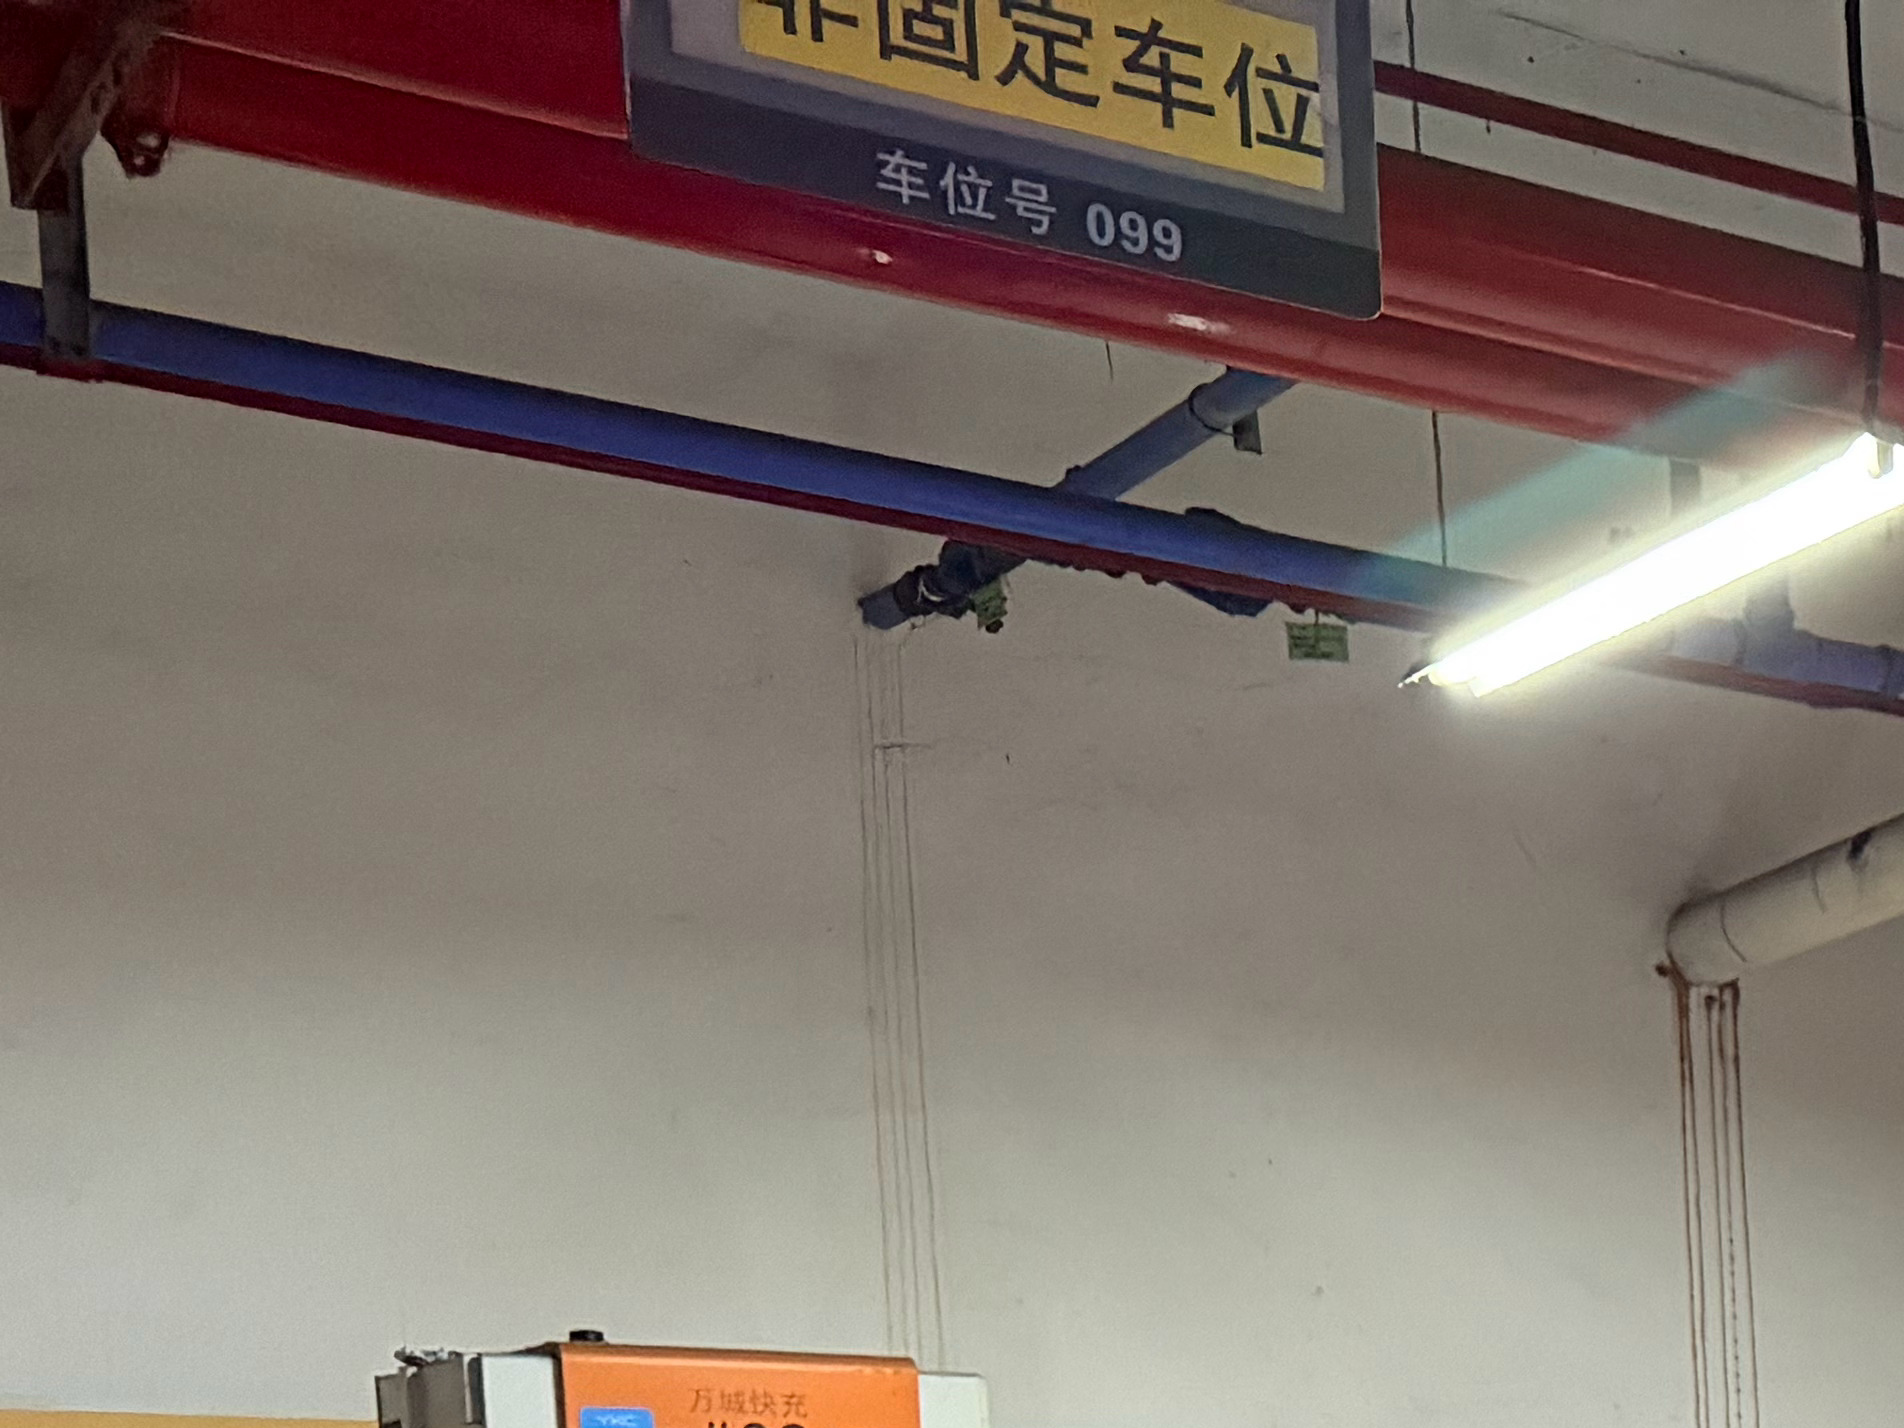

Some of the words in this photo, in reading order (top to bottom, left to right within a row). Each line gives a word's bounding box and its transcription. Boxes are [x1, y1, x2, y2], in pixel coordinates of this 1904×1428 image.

[875, 148, 1057, 235] 车位号
[1085, 202, 1184, 263] 099
